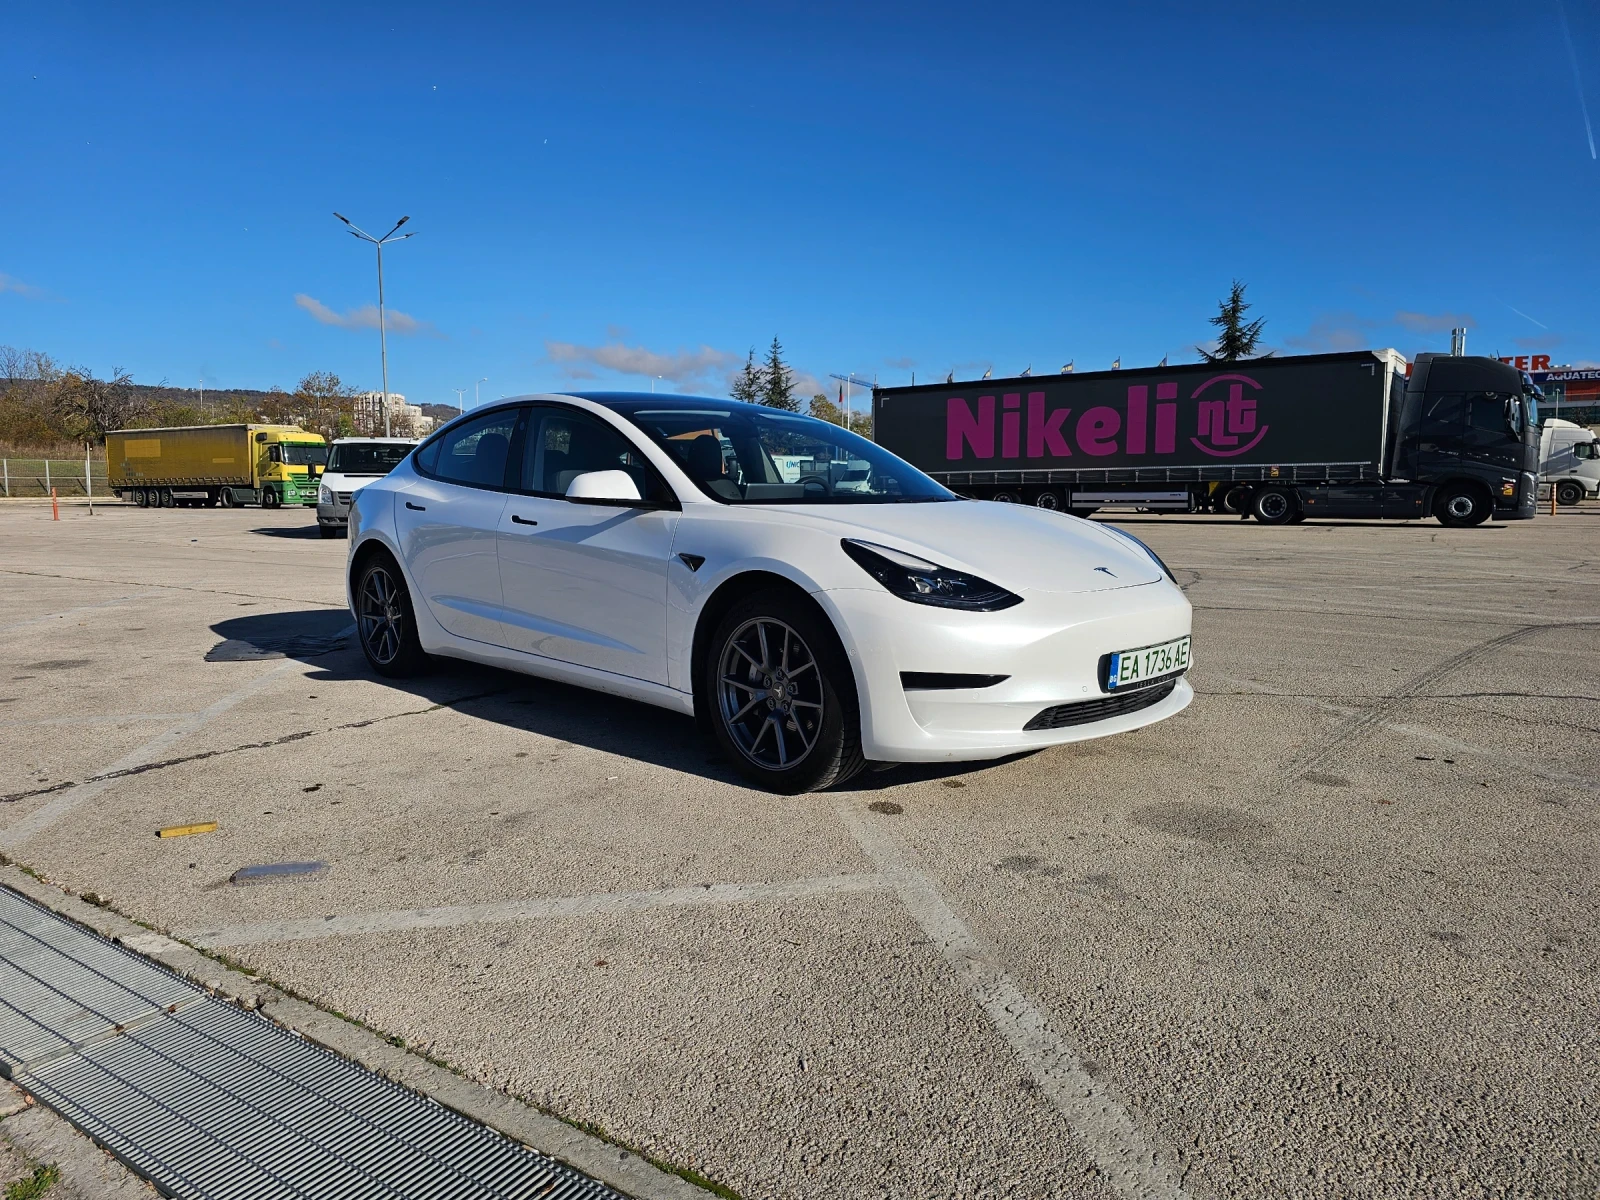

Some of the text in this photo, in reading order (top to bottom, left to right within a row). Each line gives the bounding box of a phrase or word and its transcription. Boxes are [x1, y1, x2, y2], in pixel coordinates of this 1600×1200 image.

[1500, 355, 1551, 371] TER
[946, 383, 1178, 460] Nikeli
[1120, 642, 1188, 681] EA 1736 AE
